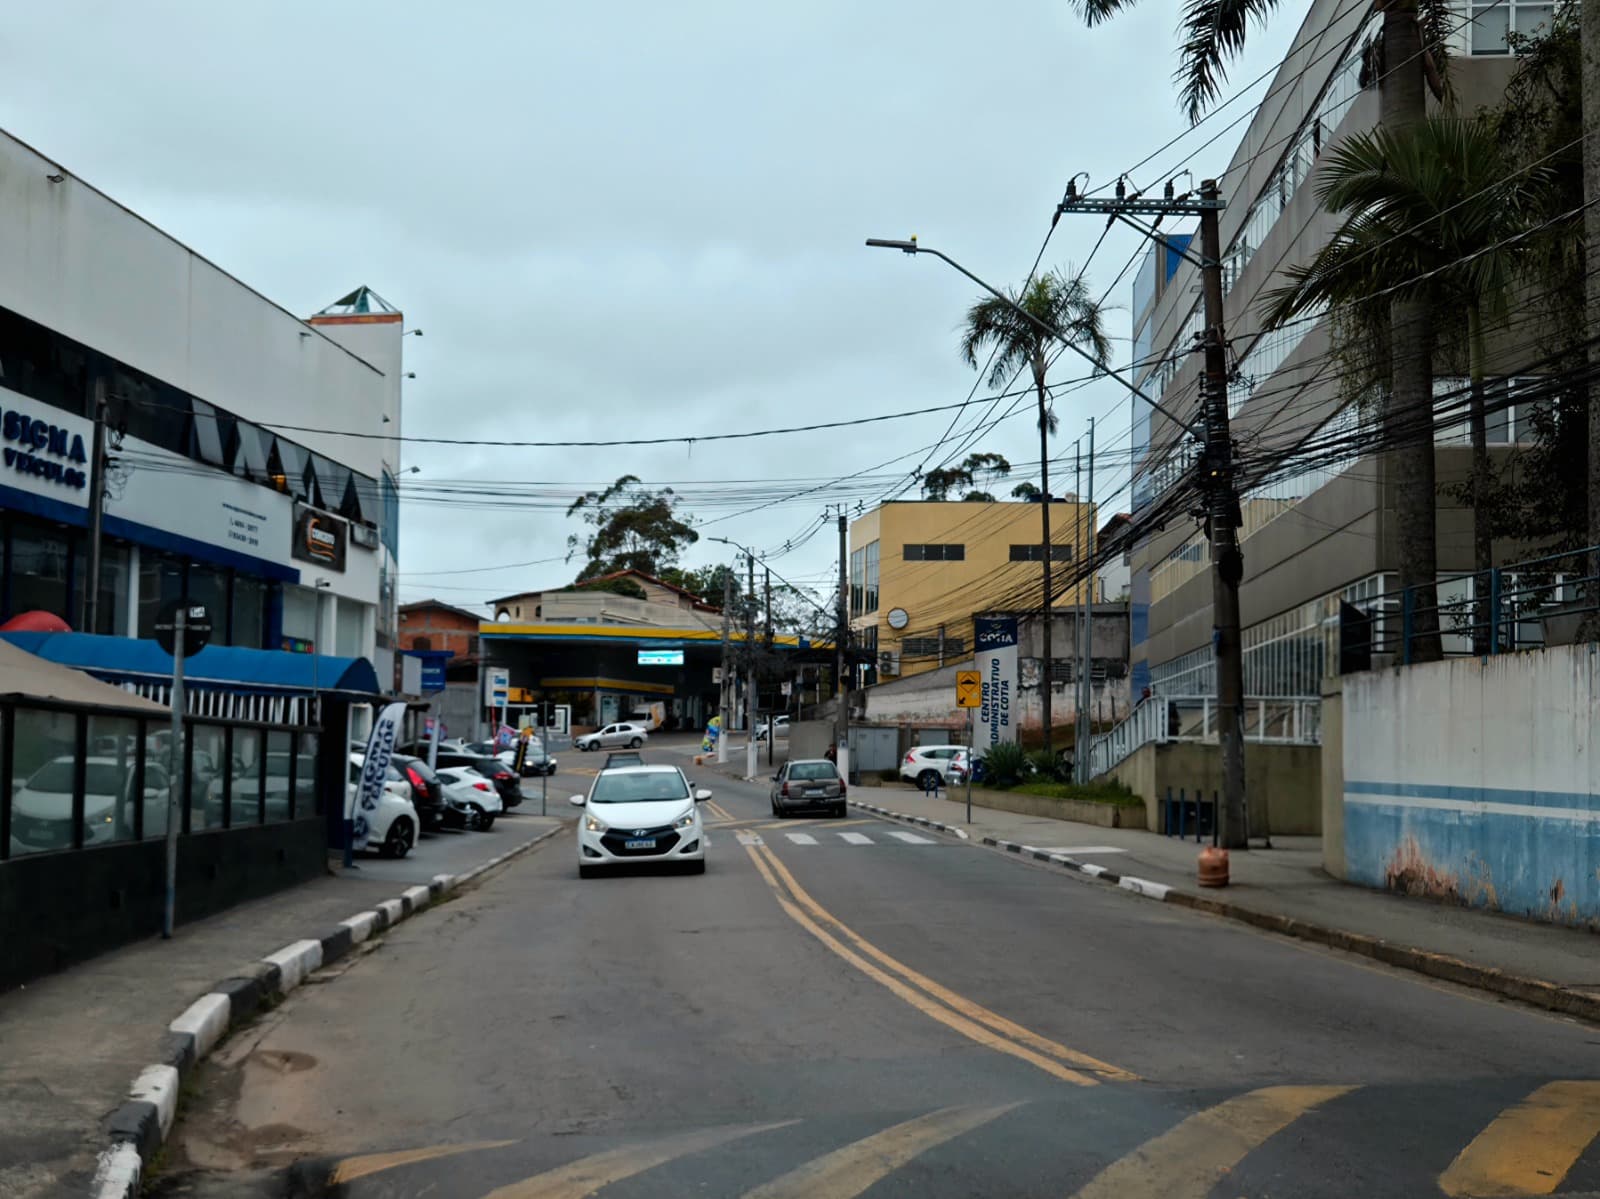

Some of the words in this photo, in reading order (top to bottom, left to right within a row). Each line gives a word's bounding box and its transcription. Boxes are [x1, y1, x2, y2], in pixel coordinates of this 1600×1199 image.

[3, 410, 87, 464] SIGMA
[979, 632, 1013, 643] COTIA
[981, 682, 990, 723] CENTRO
[1000, 680, 1009, 710] COTIA
[1000, 712, 1009, 726] DE
